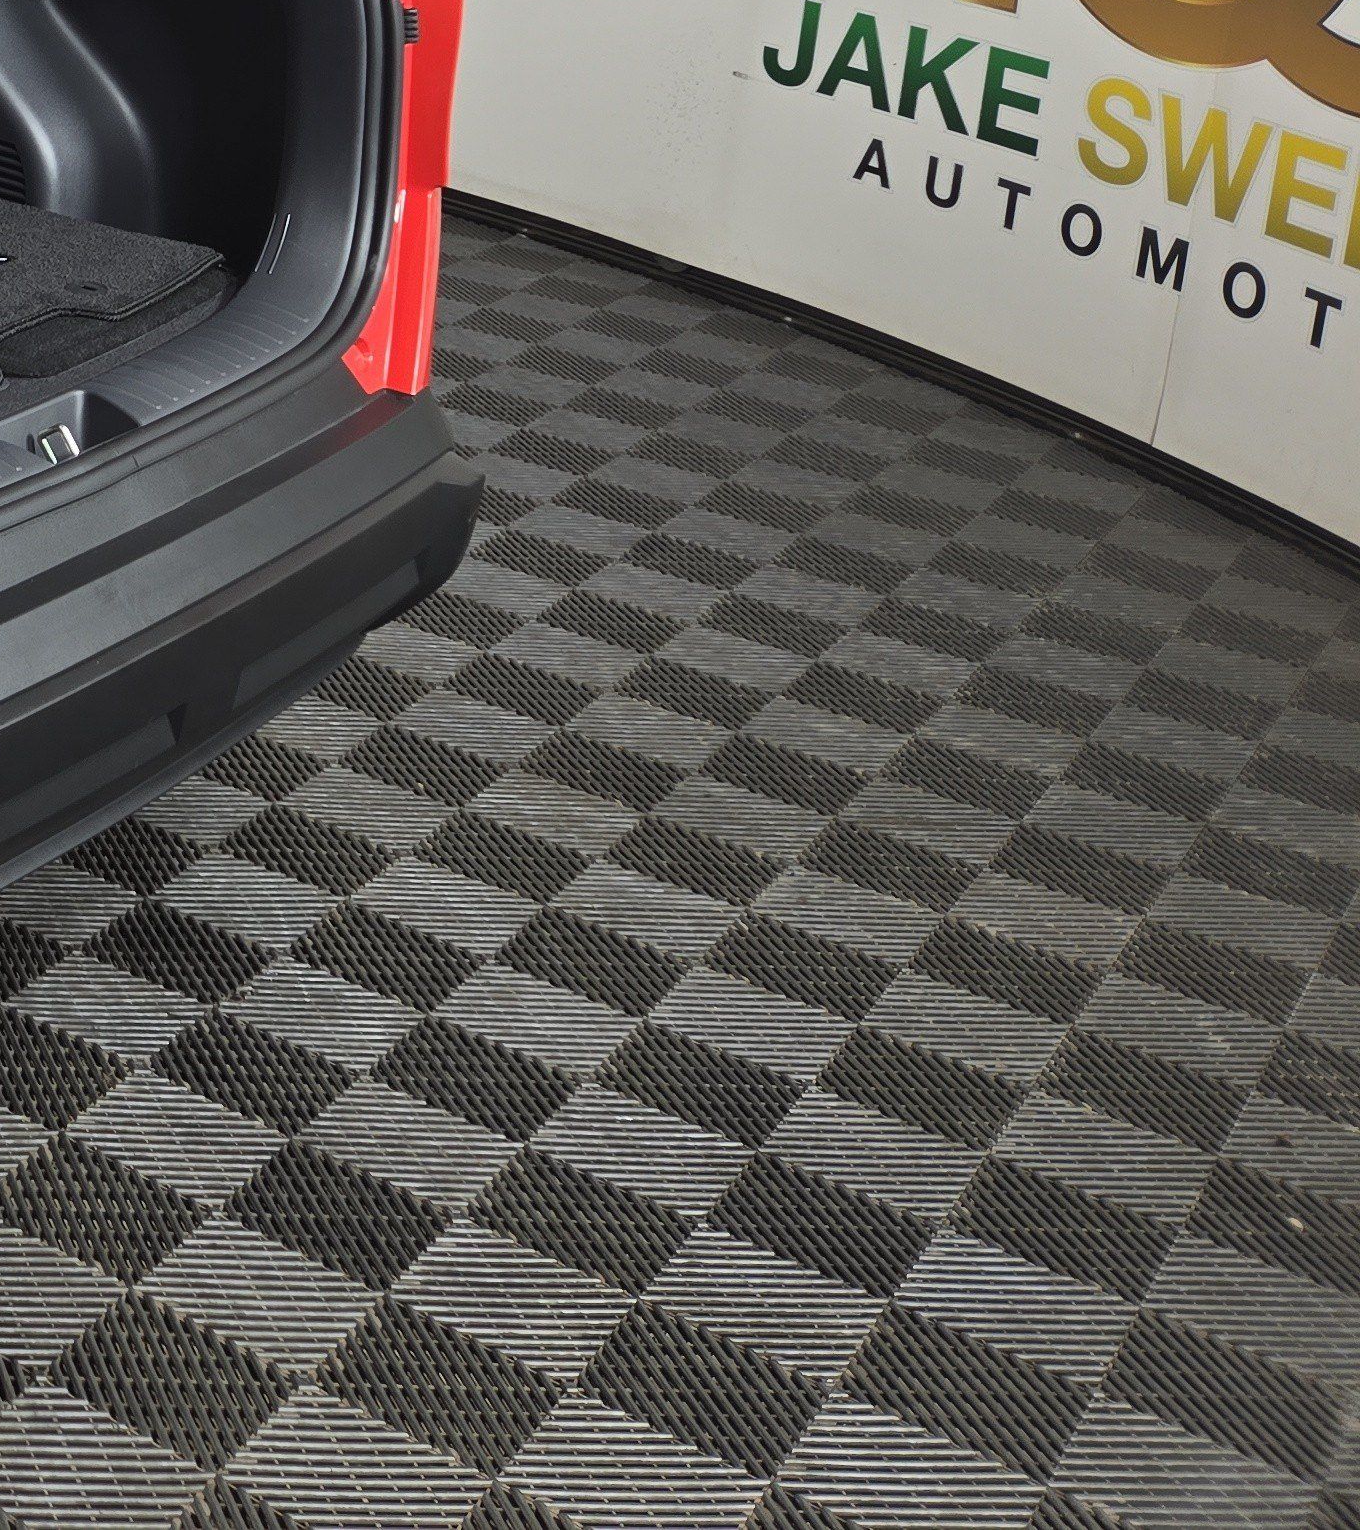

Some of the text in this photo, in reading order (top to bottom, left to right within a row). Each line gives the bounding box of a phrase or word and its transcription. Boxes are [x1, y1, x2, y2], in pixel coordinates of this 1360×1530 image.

[762, 0, 1360, 270] JAKE SWE
[852, 139, 1344, 349] AUTOMOT
